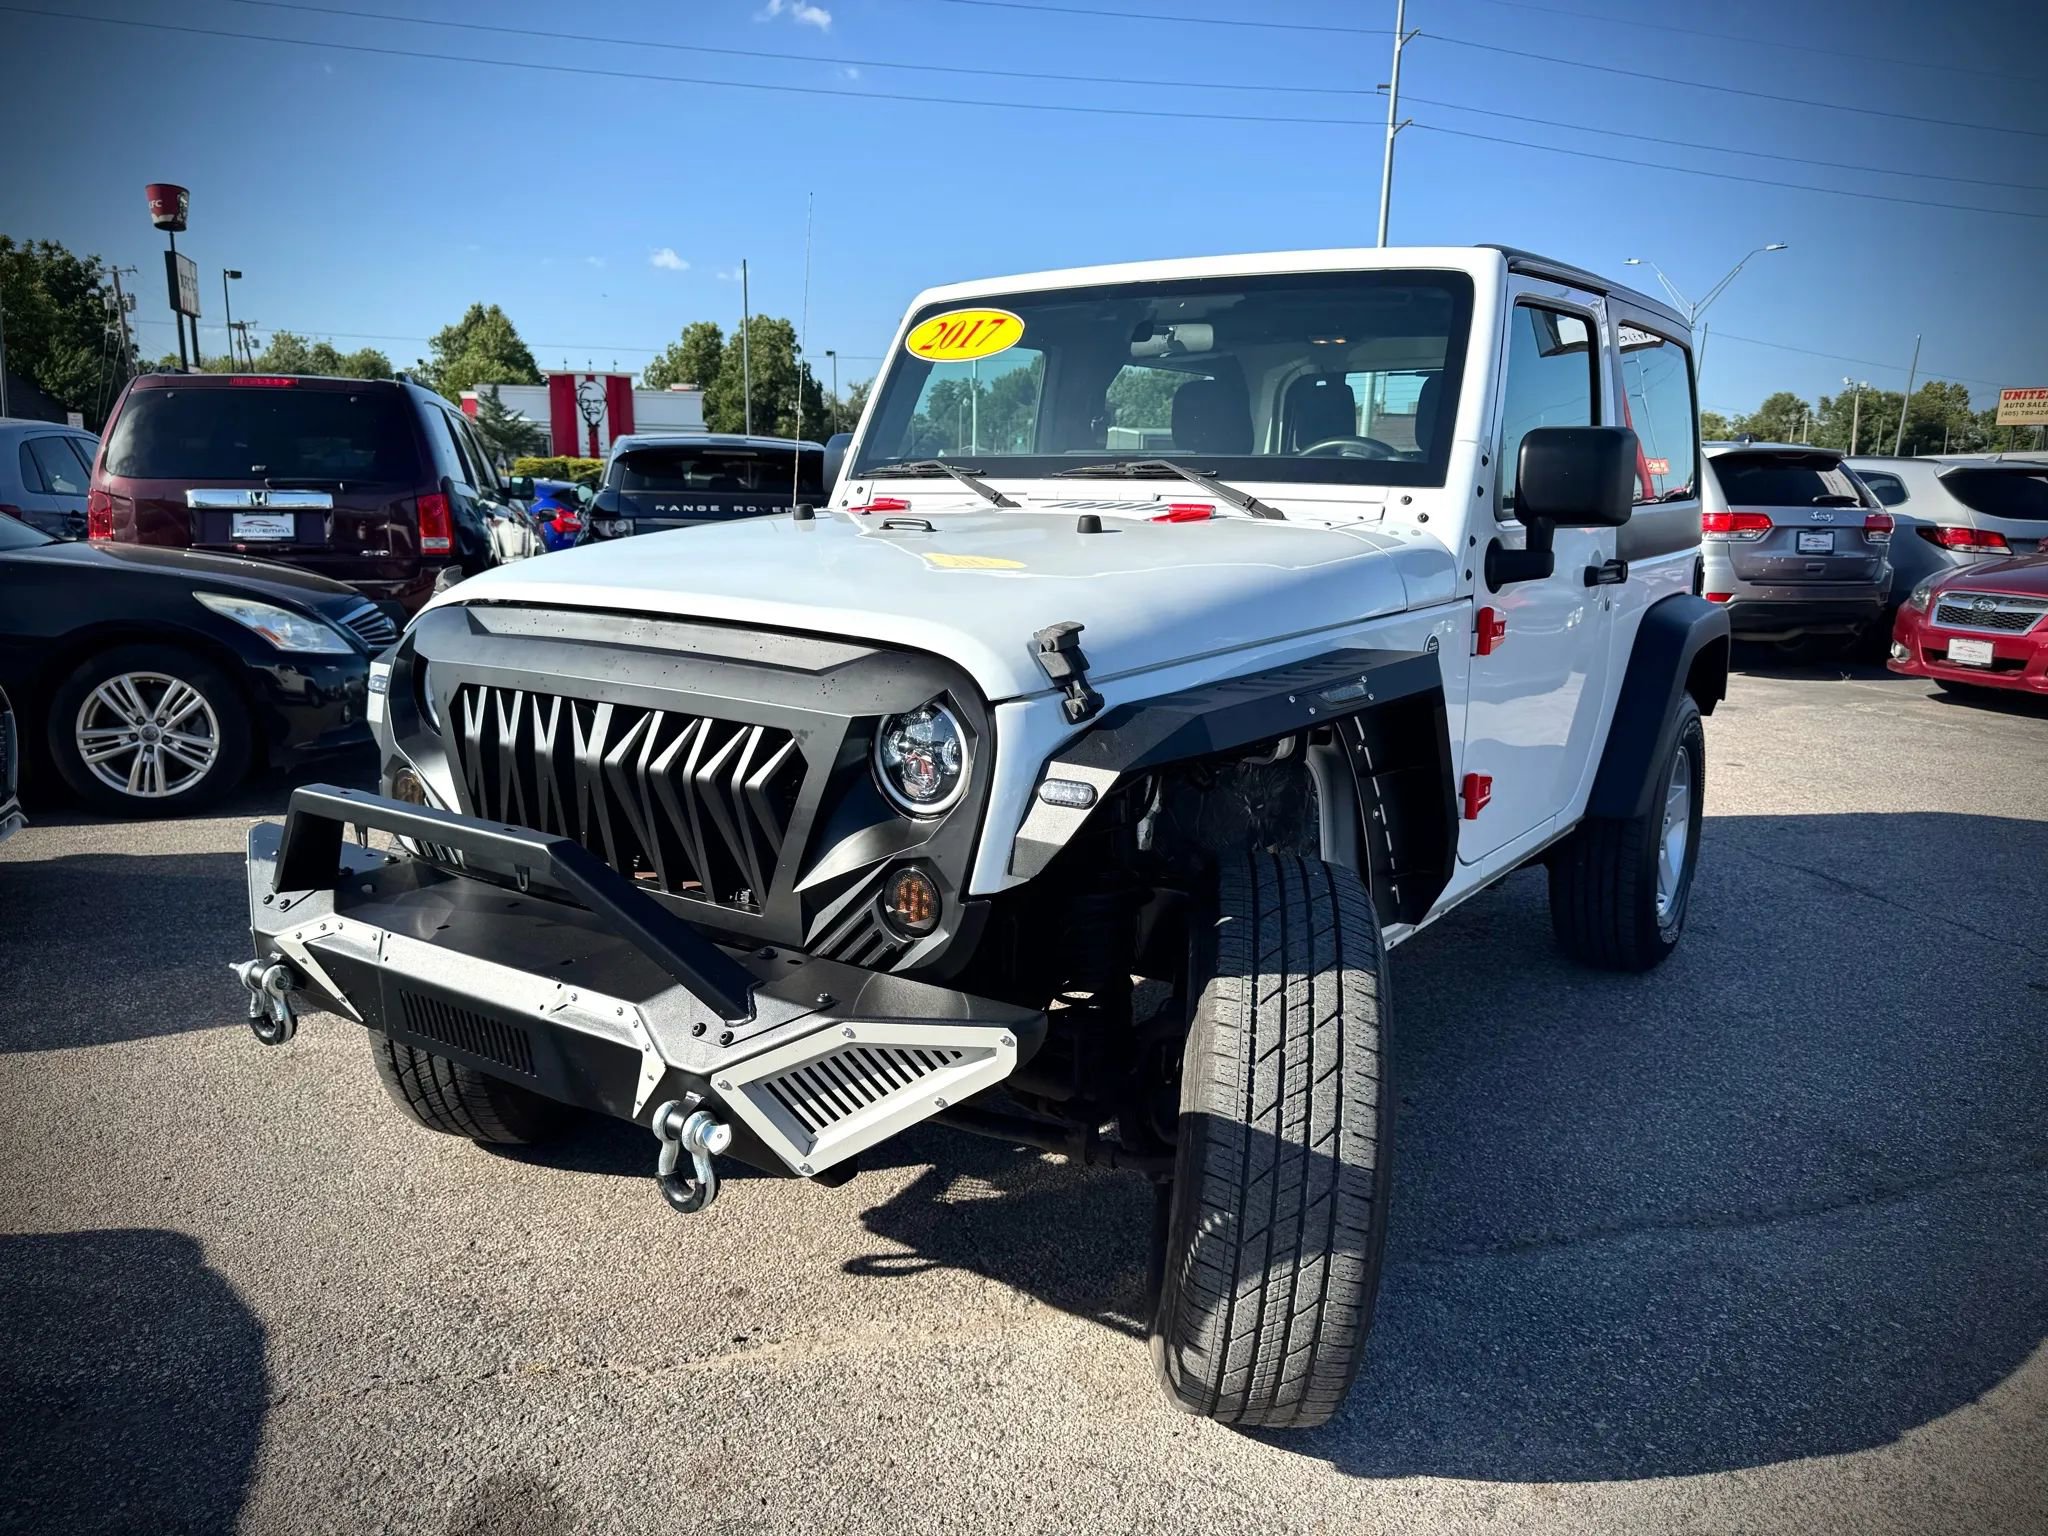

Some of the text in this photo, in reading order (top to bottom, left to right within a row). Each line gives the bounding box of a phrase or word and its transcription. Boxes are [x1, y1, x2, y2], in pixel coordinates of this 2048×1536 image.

[918, 318, 1008, 351] 2017
[2003, 390, 2048, 400] UNITE
[1810, 511, 1834, 523] Jeep
